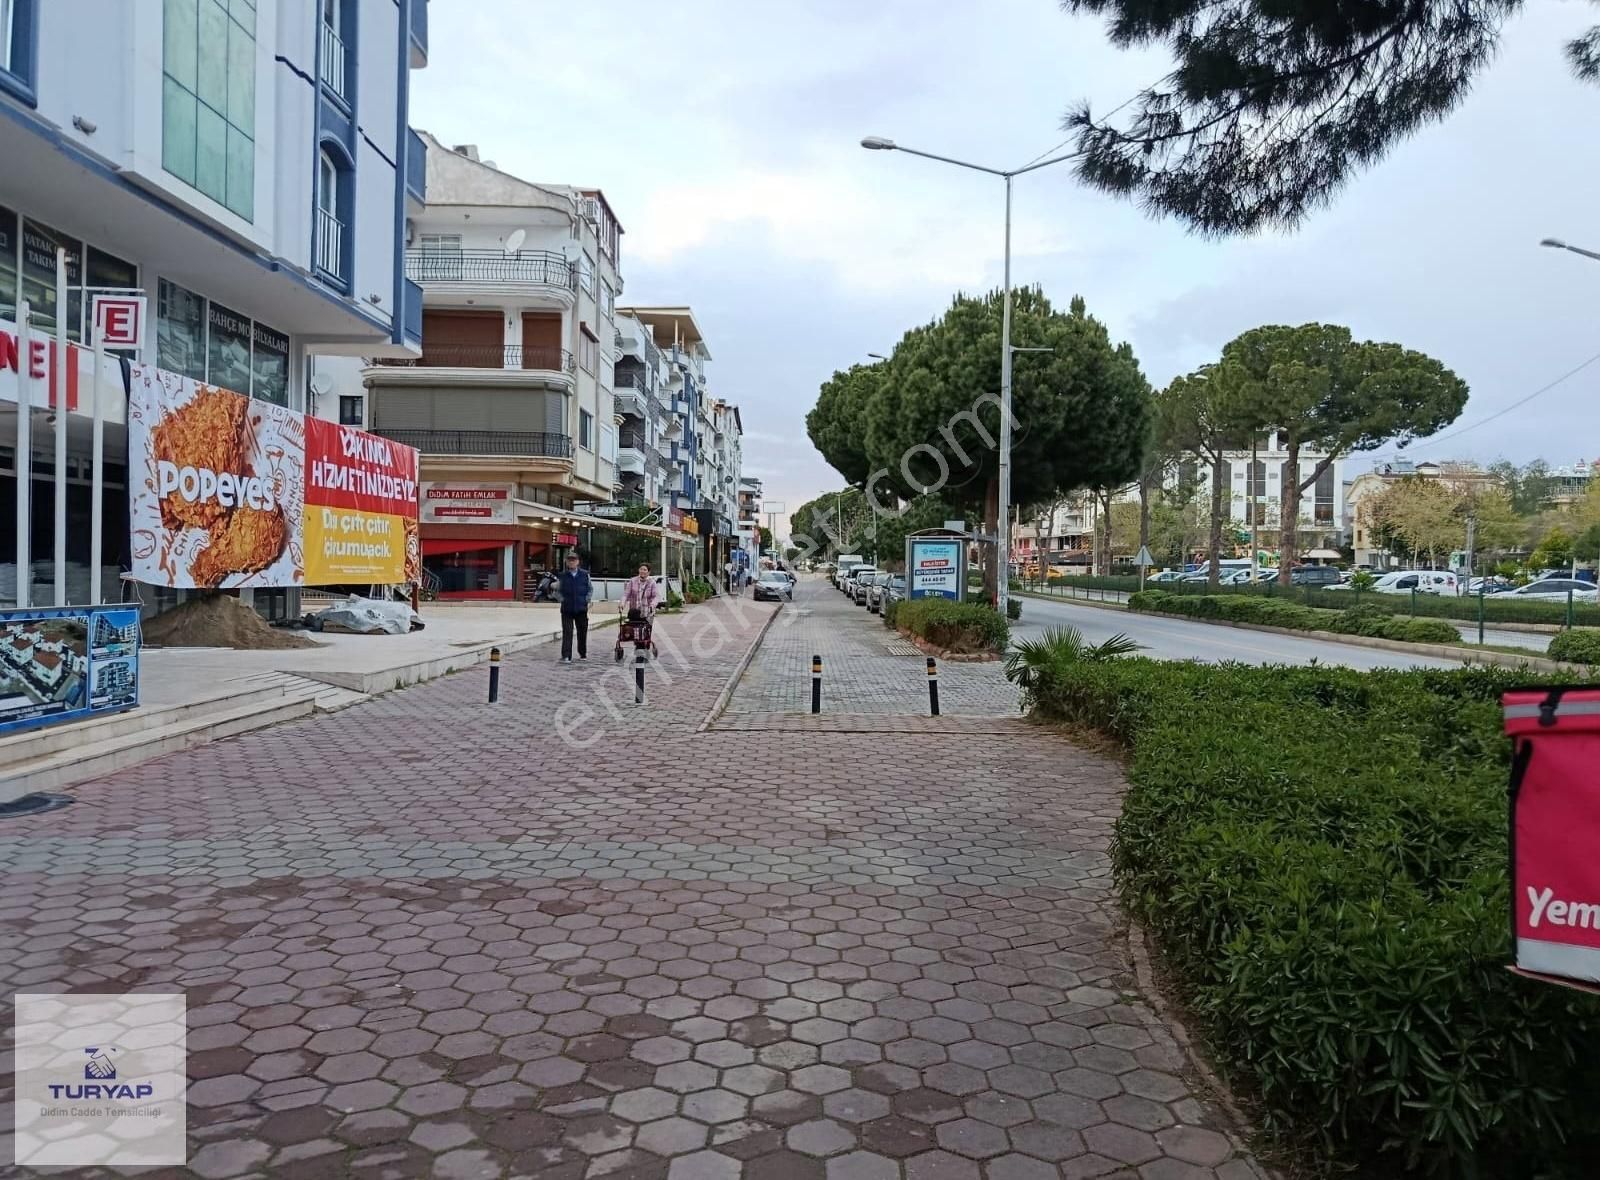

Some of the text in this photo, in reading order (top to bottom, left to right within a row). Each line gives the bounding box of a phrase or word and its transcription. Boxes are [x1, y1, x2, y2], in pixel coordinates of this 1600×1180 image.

[24, 232, 52, 253] YATAK
[27, 250, 76, 278] TAKIMRI
[106, 308, 129, 337] E
[209, 309, 237, 332] BAHÇE
[339, 430, 393, 468] YAKINDA
[312, 454, 417, 502] HİZMETİNİZDEYİZ
[1527, 886, 1600, 929] Yem
